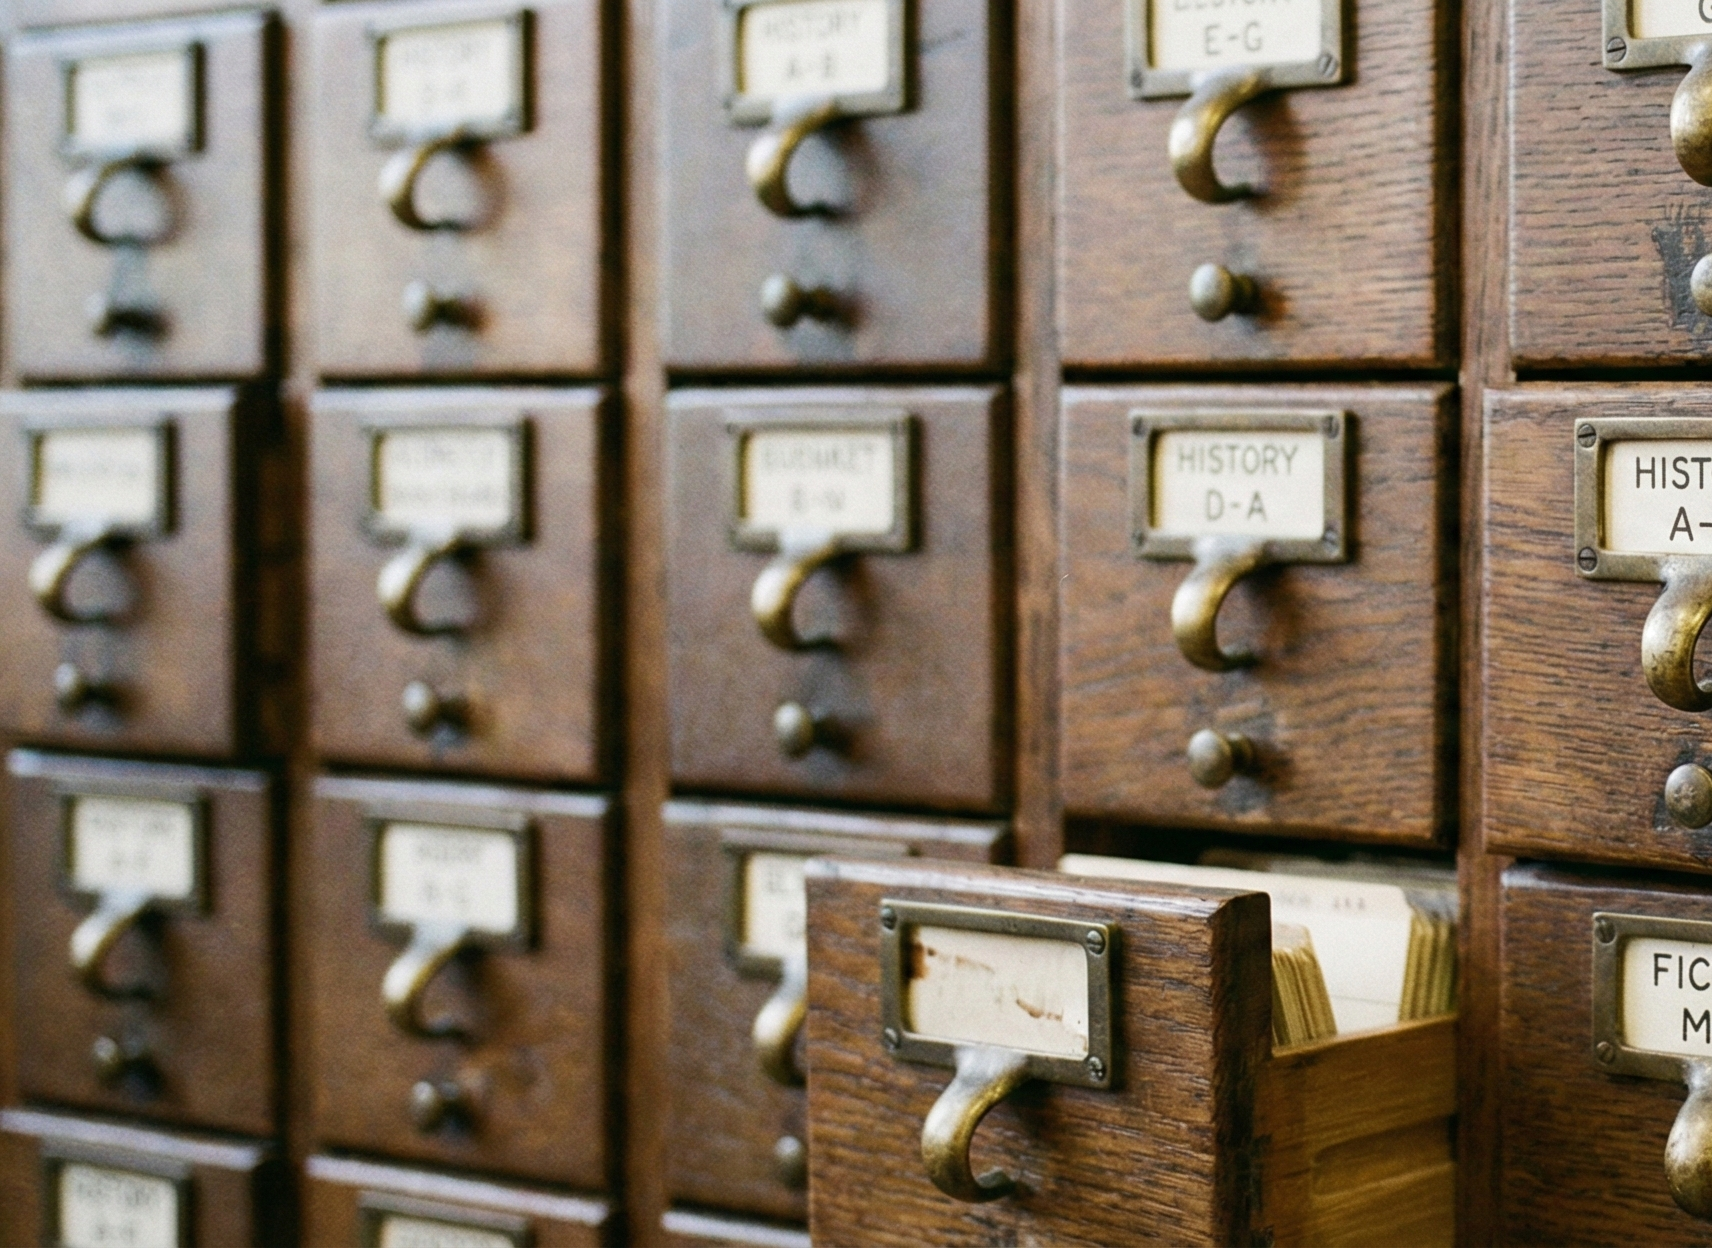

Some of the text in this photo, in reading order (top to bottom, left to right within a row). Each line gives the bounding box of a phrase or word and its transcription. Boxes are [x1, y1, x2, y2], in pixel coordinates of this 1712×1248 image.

[1205, 21, 1262, 55] E-G
[1177, 444, 1298, 474] HISTORY
[1206, 489, 1266, 522] D-A
